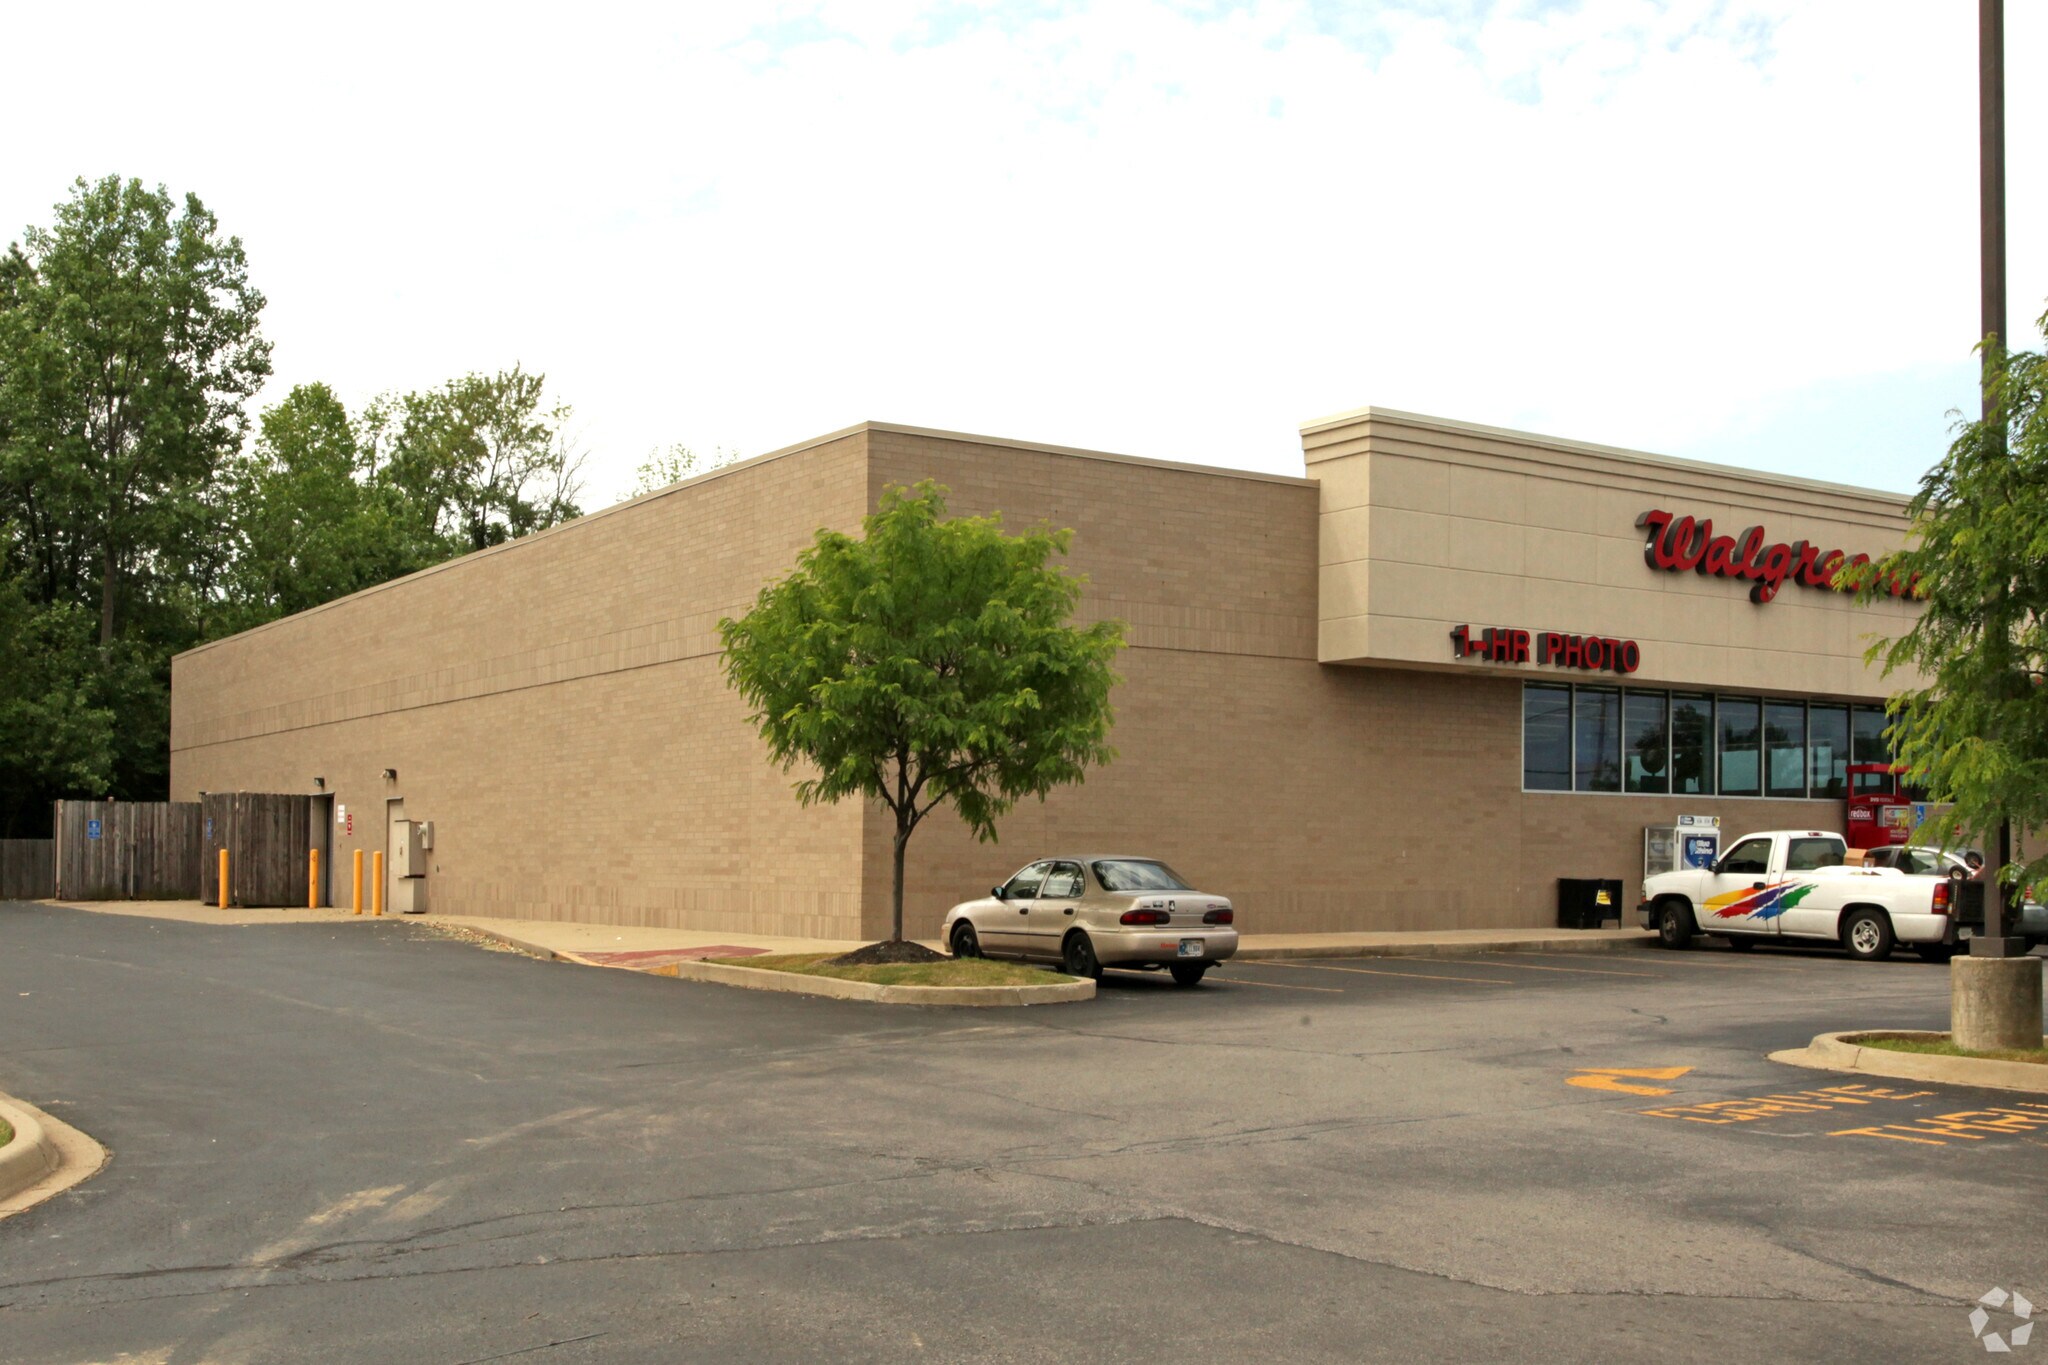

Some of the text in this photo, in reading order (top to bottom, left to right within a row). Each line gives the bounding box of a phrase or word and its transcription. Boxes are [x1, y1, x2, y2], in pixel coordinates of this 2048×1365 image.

[1636, 508, 1932, 603] Walgree
[1451, 624, 1640, 673] 1-HR PHOTO
[1850, 808, 1871, 818] redbox
[1637, 1084, 1936, 1124] DRIVE
